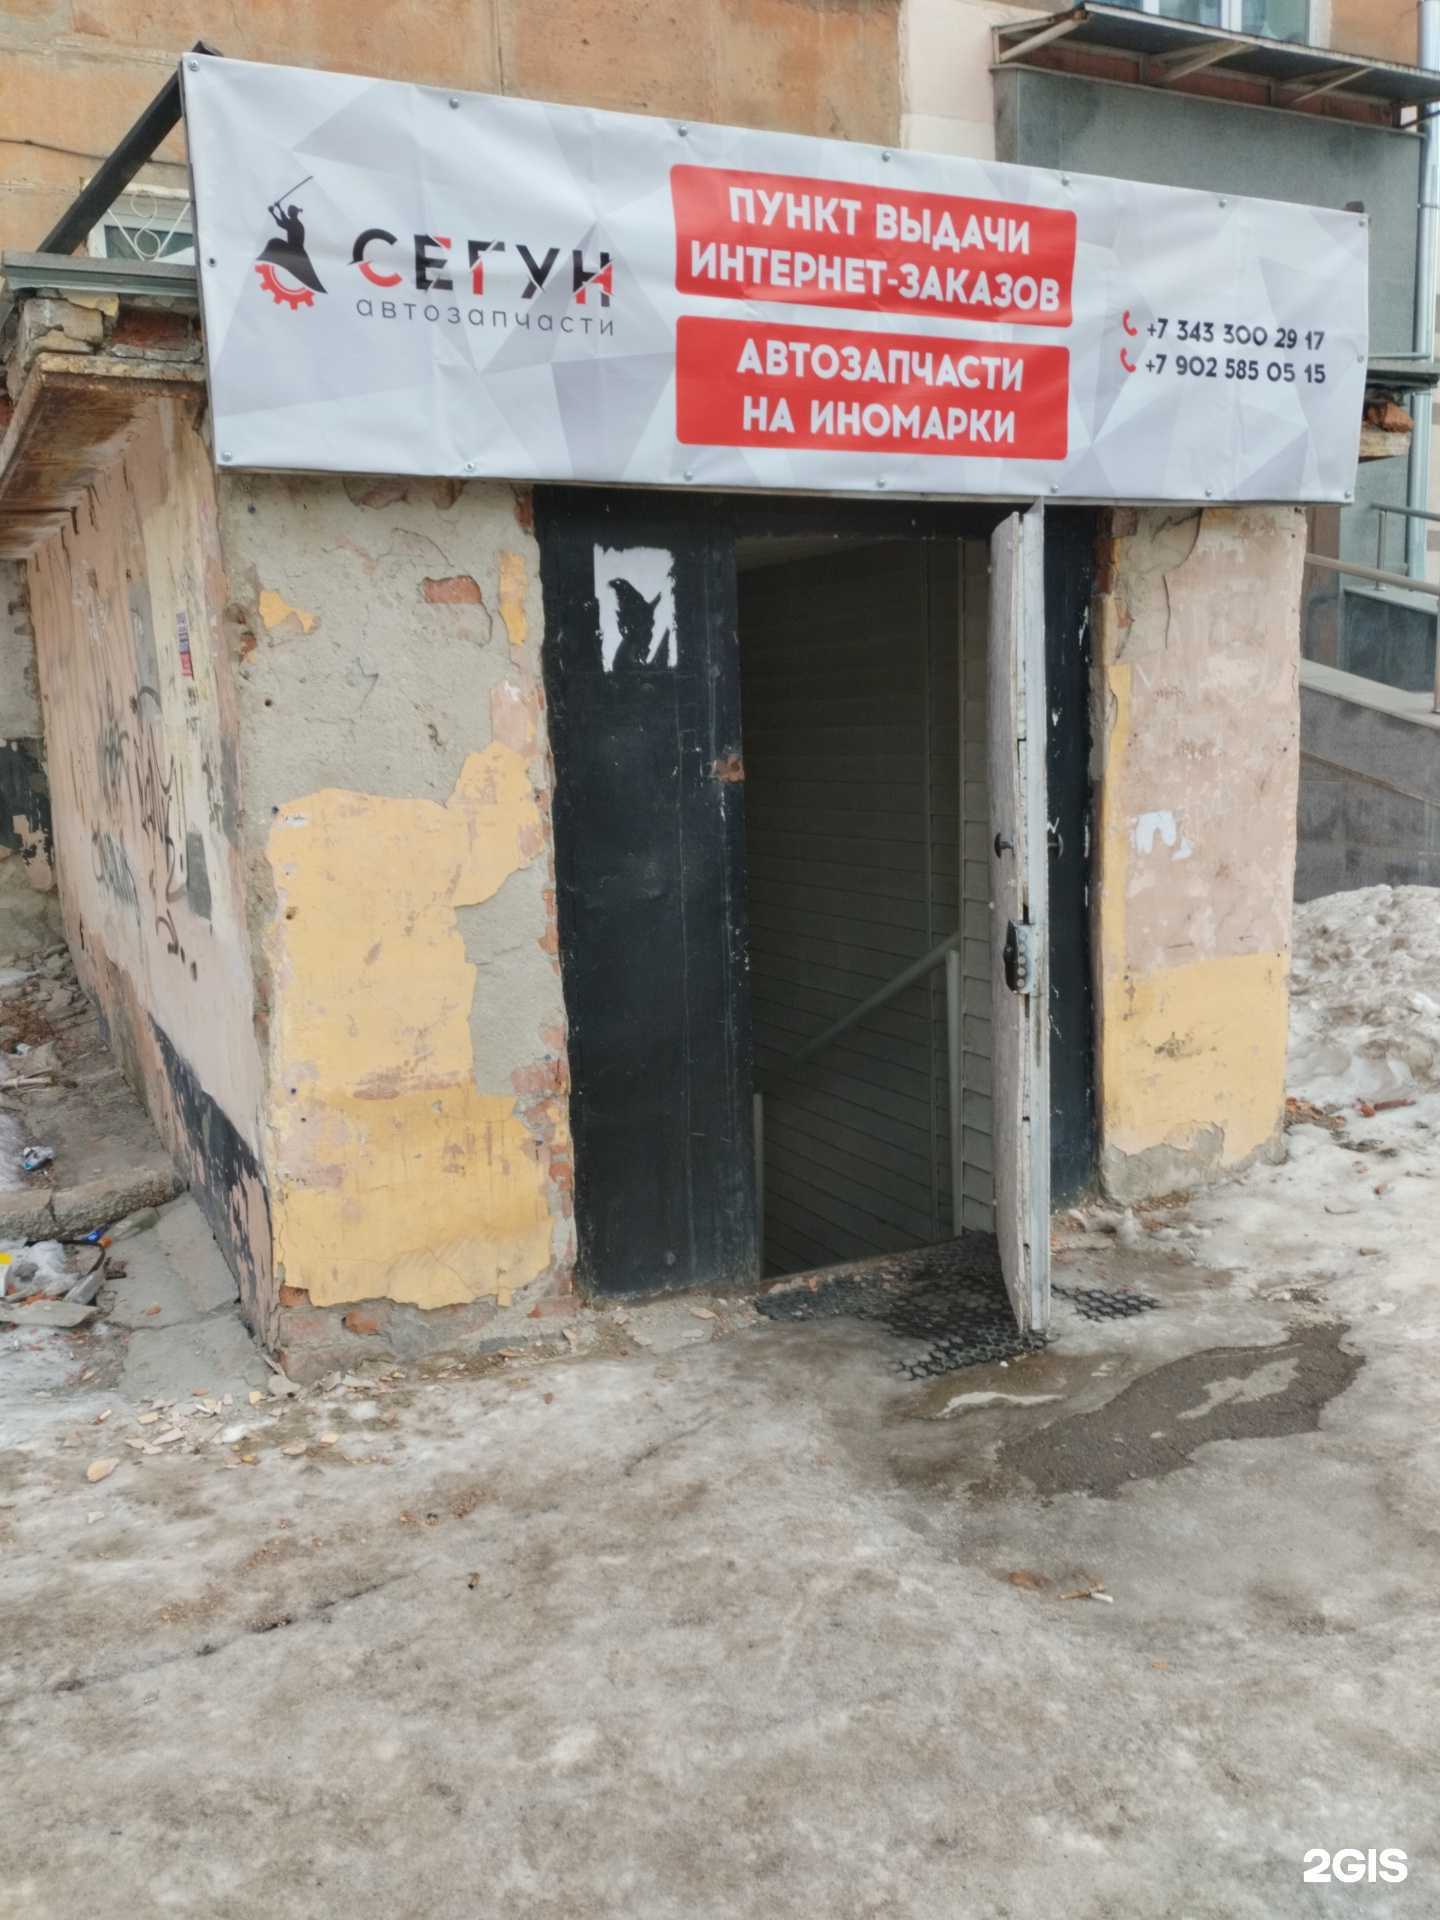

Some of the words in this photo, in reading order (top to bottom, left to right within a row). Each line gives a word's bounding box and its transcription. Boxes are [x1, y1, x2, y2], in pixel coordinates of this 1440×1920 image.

[729, 187, 862, 236] ПУНКТ
[875, 203, 1031, 255] ВЫДАЧИ
[348, 227, 615, 307] СЕГУН
[690, 240, 1060, 313] ИНТЕРНЕТ-ЗАКАЗОВ
[356, 298, 614, 337] автозапчасти
[1147, 318, 1169, 339] +7
[1177, 319, 1214, 343] 343
[1223, 324, 1268, 346] 300
[1274, 328, 1298, 349] 29
[1305, 331, 1325, 350] 17
[736, 338, 1024, 392] АВТОЗАПЧАСТИ
[1145, 354, 1167, 375] +7
[1175, 355, 1217, 378] 902
[1225, 358, 1259, 381] 585
[1267, 362, 1296, 382] 05
[1304, 364, 1326, 384] 15
[742, 396, 796, 433] НА
[810, 400, 1015, 444] ИНОМАРКИ
